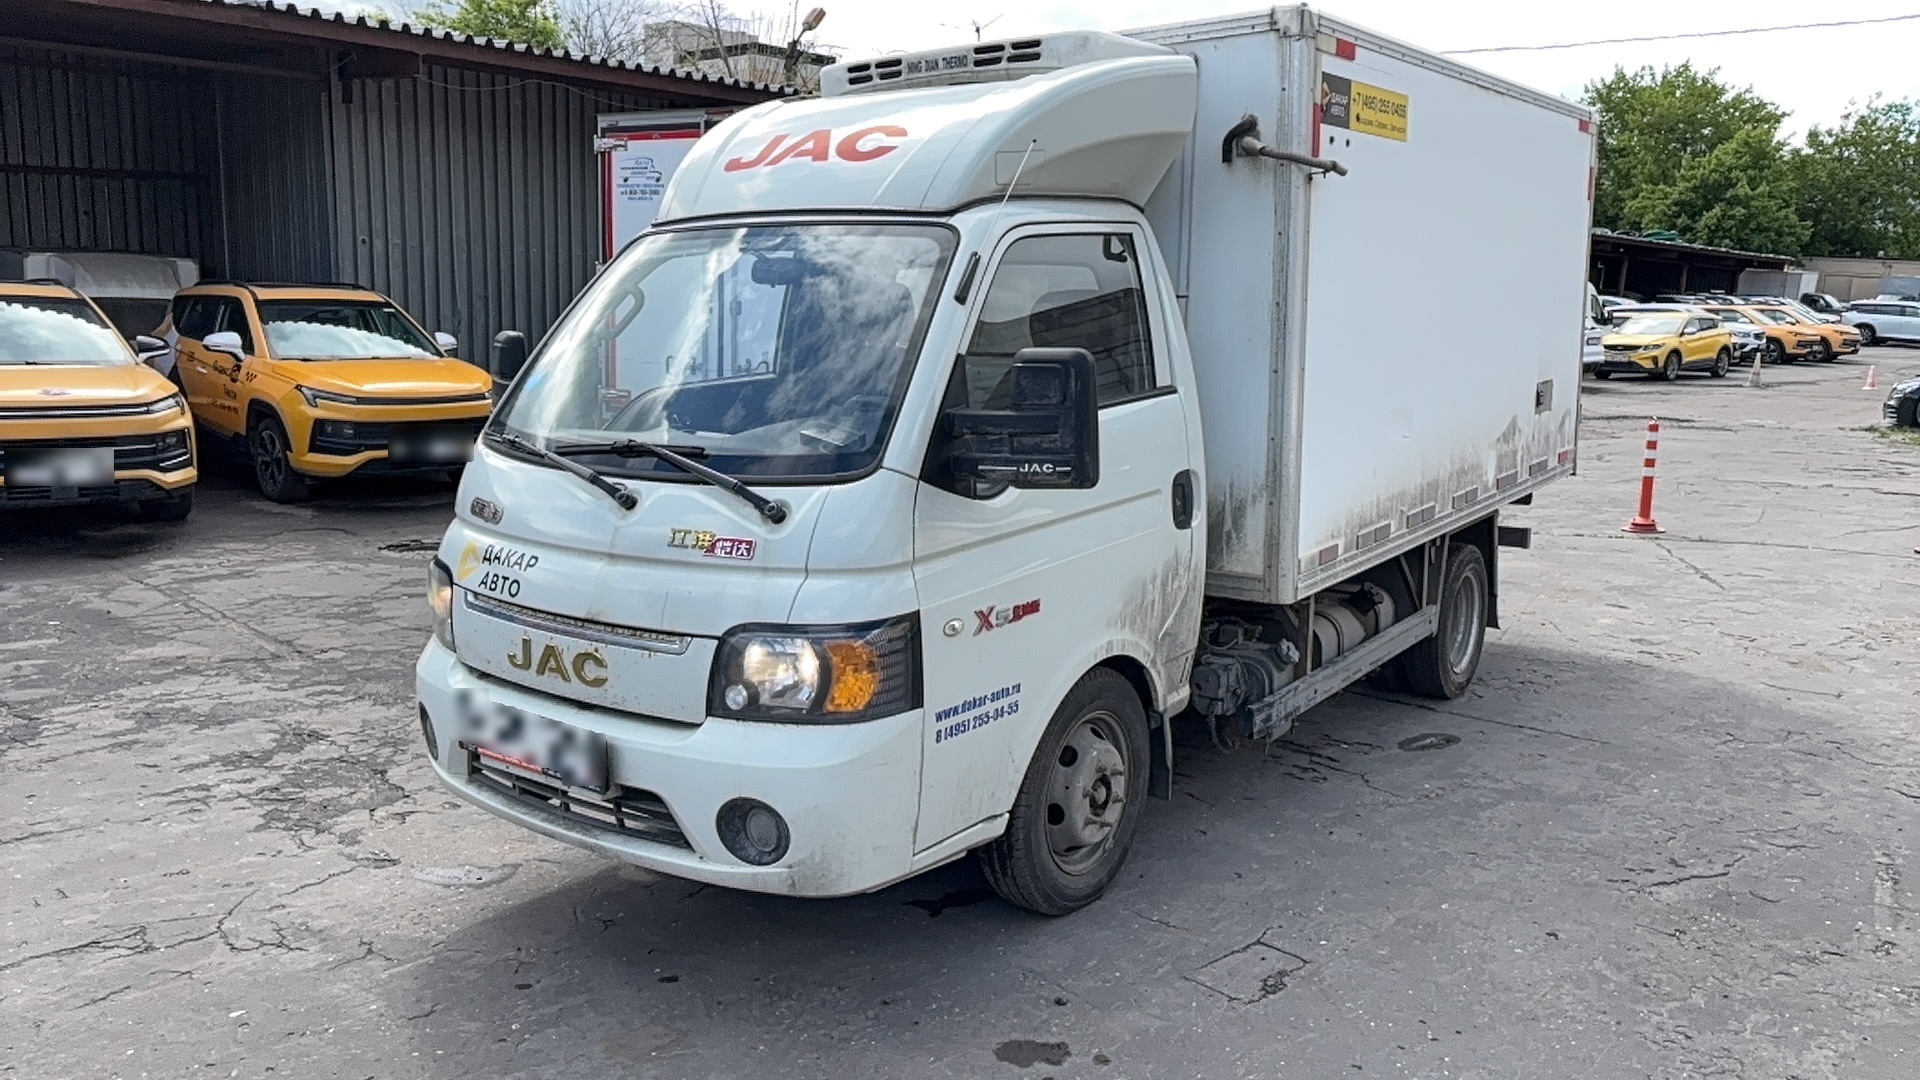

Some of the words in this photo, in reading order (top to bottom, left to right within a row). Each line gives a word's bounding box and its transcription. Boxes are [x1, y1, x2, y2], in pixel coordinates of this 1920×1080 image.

[941, 54, 968, 70] THERMO
[724, 125, 908, 173] JAC
[1019, 463, 1054, 473] JAC
[482, 544, 539, 573] ДАКАР
[478, 571, 521, 598] АВТО
[507, 636, 608, 688] JAC
[935, 682, 1021, 723] www.dakar-auto.ru
[935, 729, 943, 744] 8
[944, 718, 971, 740] (495)
[972, 700, 1019, 730] 255-04-55
